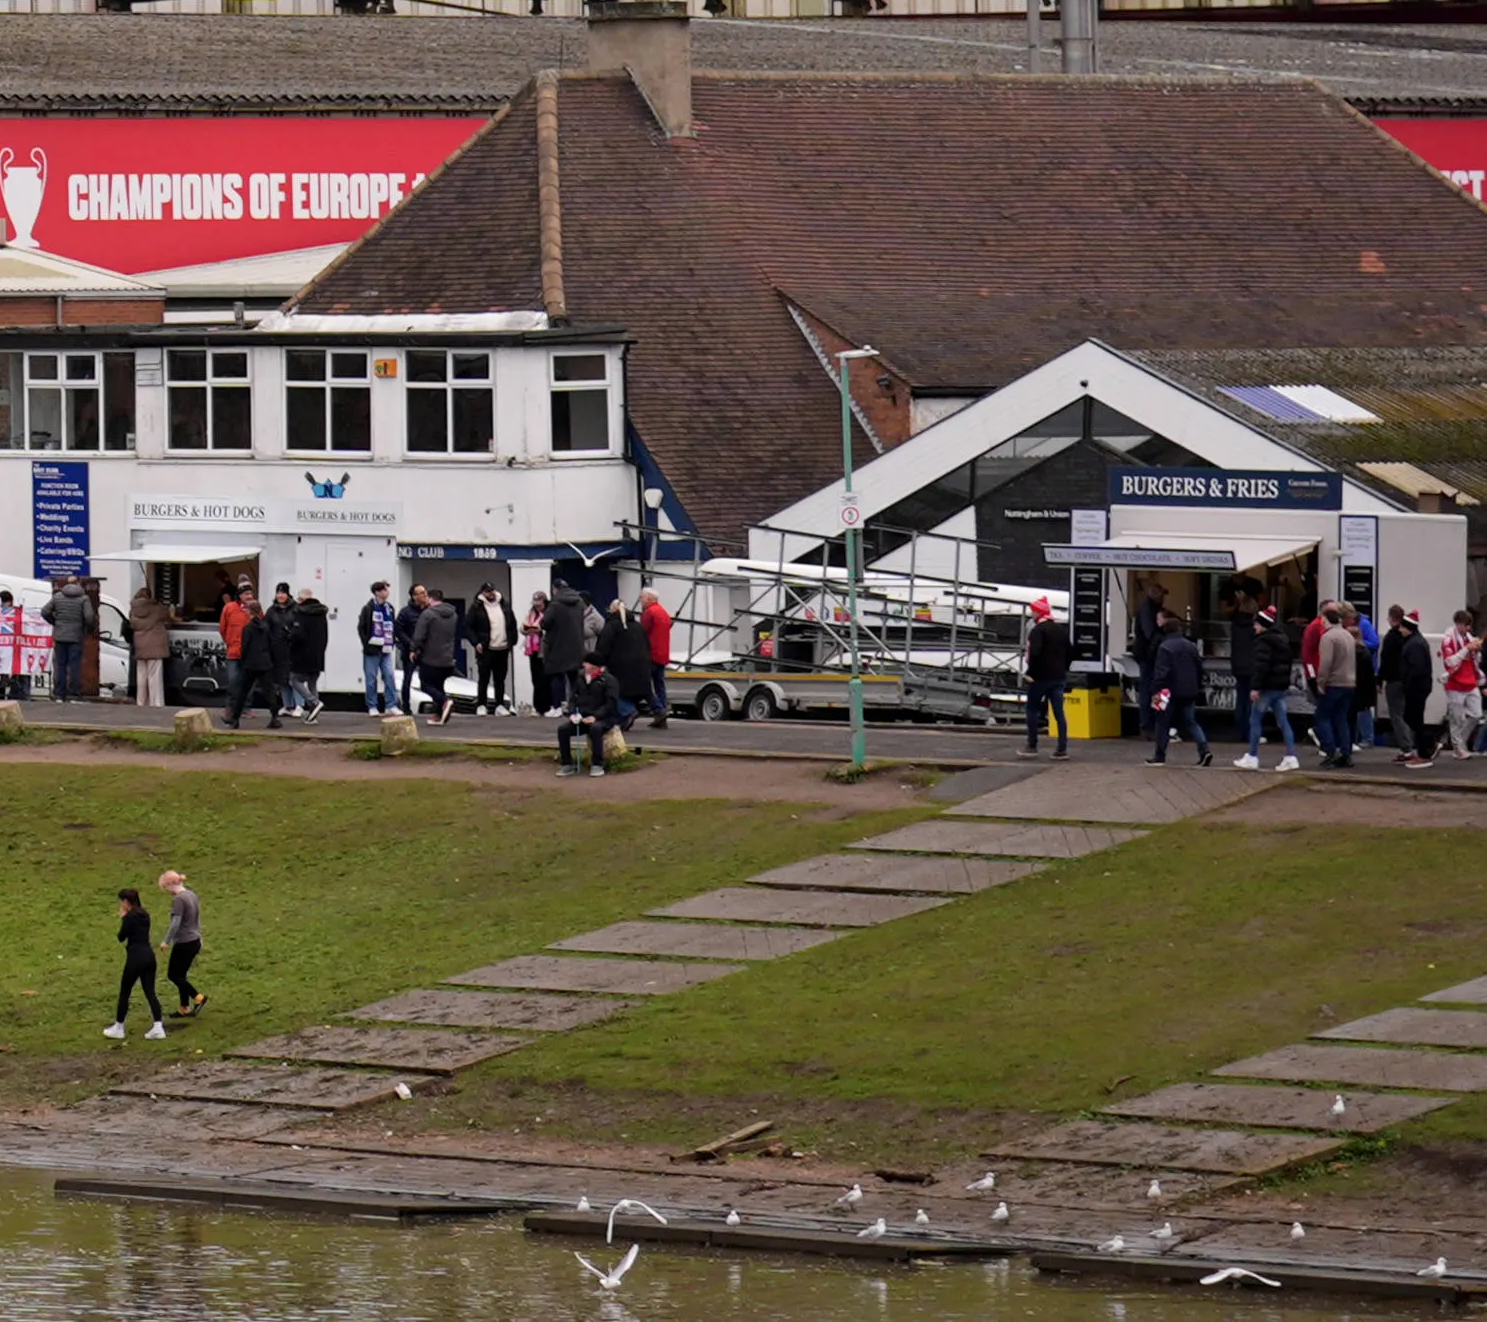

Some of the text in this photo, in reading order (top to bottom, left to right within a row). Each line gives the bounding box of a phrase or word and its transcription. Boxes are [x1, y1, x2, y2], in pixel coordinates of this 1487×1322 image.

[68, 172, 406, 221] CHAMPIONS OF EUROPE
[1122, 475, 1206, 497] BURGERS
[1208, 477, 1222, 497] &
[1226, 478, 1279, 499] FRIES
[134, 503, 265, 519] BURGERS & HOT DOGS
[296, 510, 397, 522] BURGERS & HOT DOGS
[1005, 509, 1043, 519] Nottingham
[417, 546, 444, 558] CLUB
